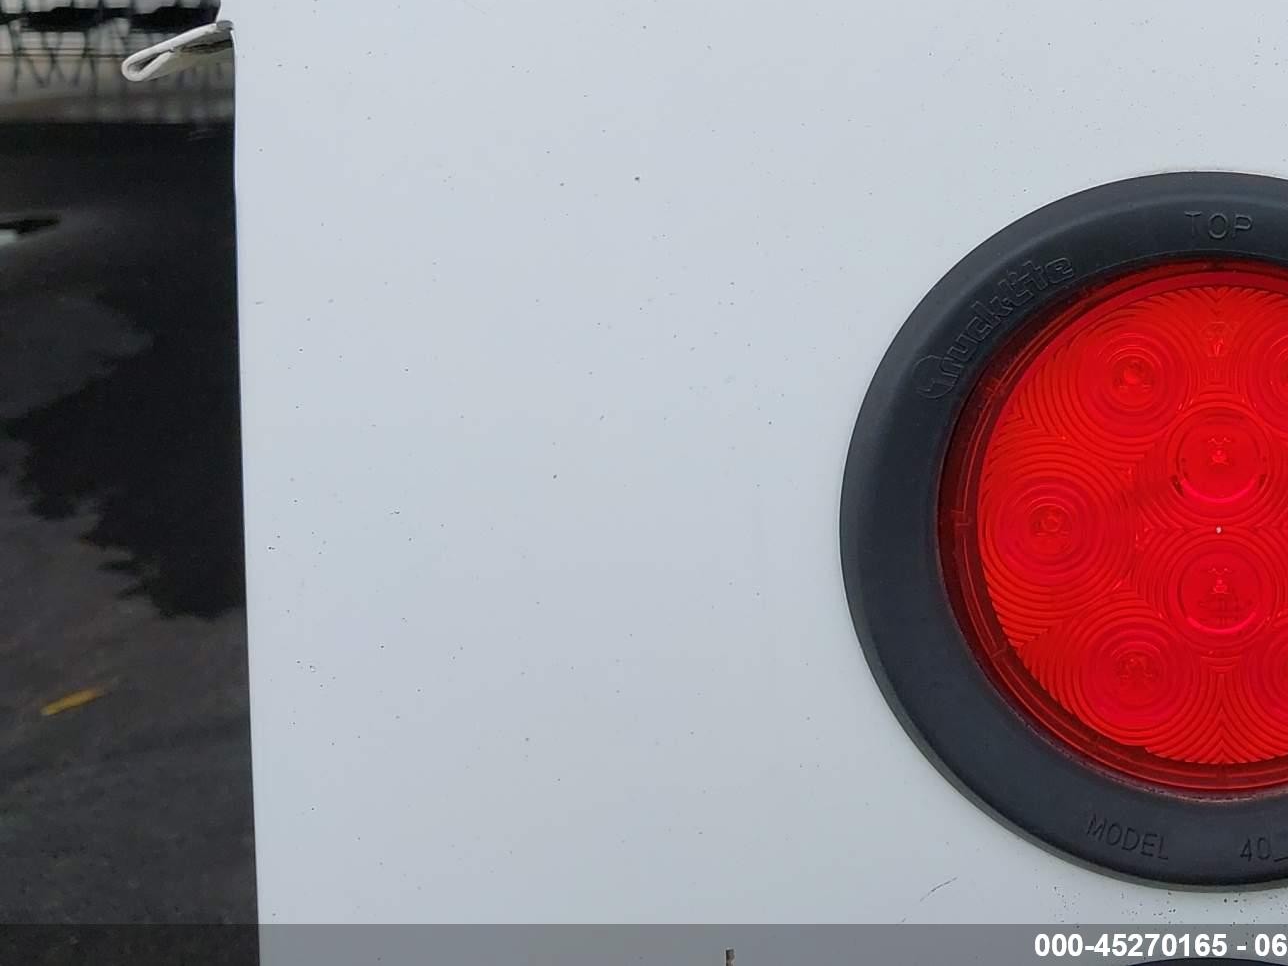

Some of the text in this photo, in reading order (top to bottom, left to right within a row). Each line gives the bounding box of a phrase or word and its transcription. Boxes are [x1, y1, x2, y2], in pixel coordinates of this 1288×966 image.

[1184, 211, 1253, 238] TOP
[1087, 813, 1273, 861] MODEL 40
